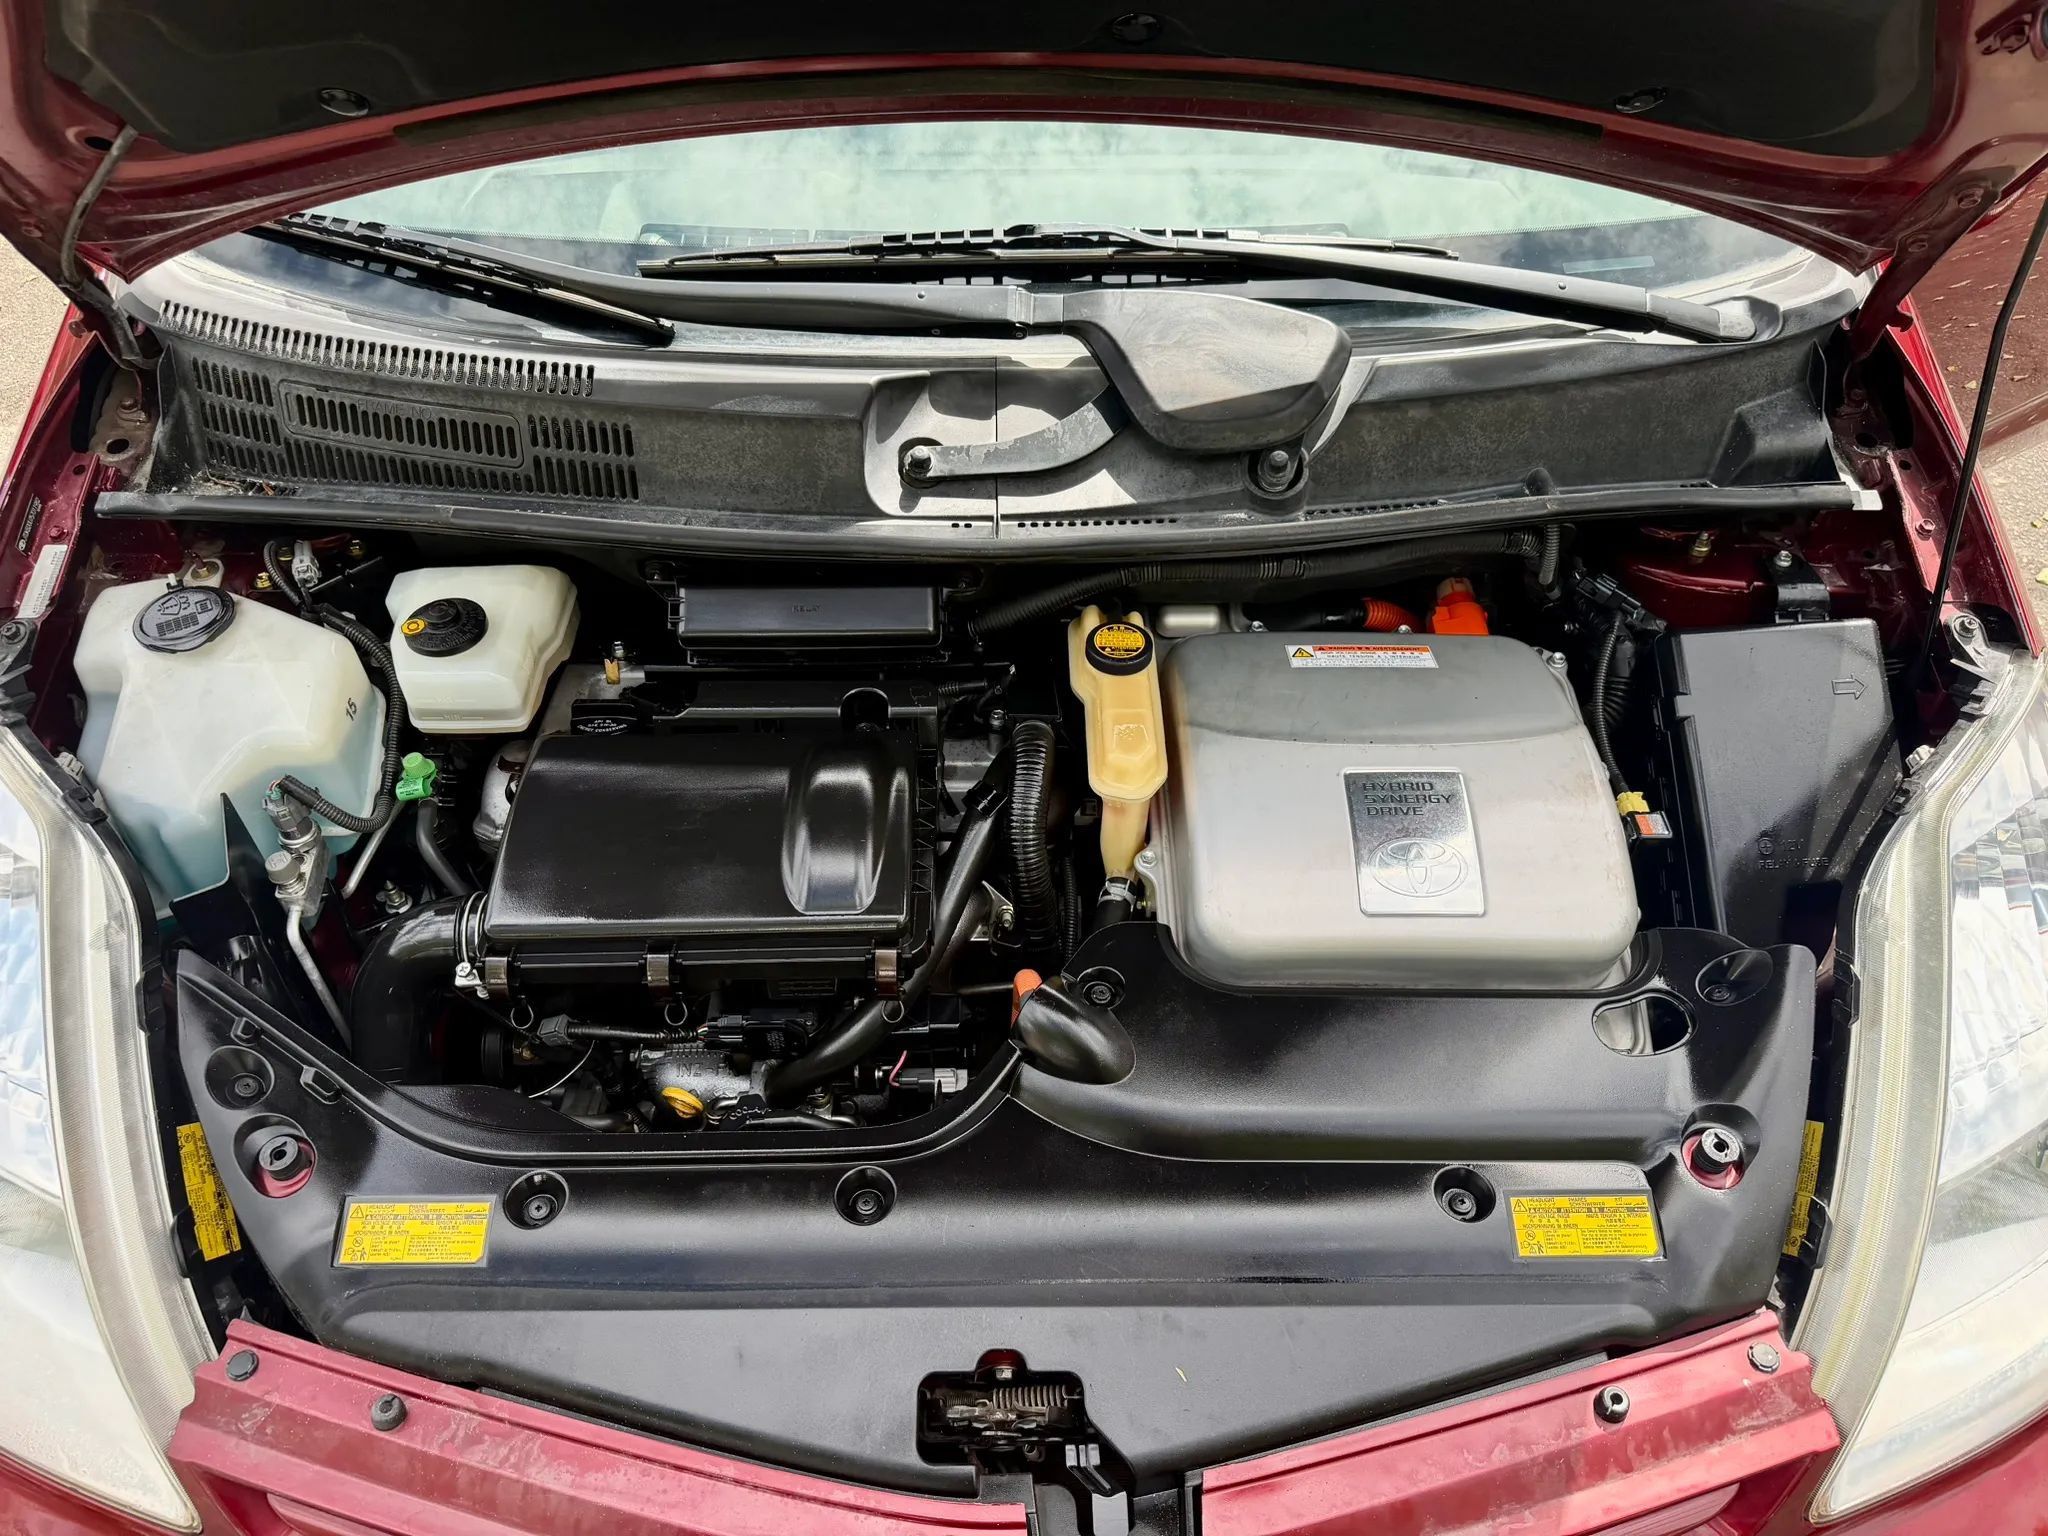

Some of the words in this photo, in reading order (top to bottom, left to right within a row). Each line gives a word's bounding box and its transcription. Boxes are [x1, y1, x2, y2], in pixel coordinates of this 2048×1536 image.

[1362, 782, 1434, 792] HYBRID
[1364, 794, 1452, 804] SYNERGY
[1367, 806, 1424, 816] DRIVE
